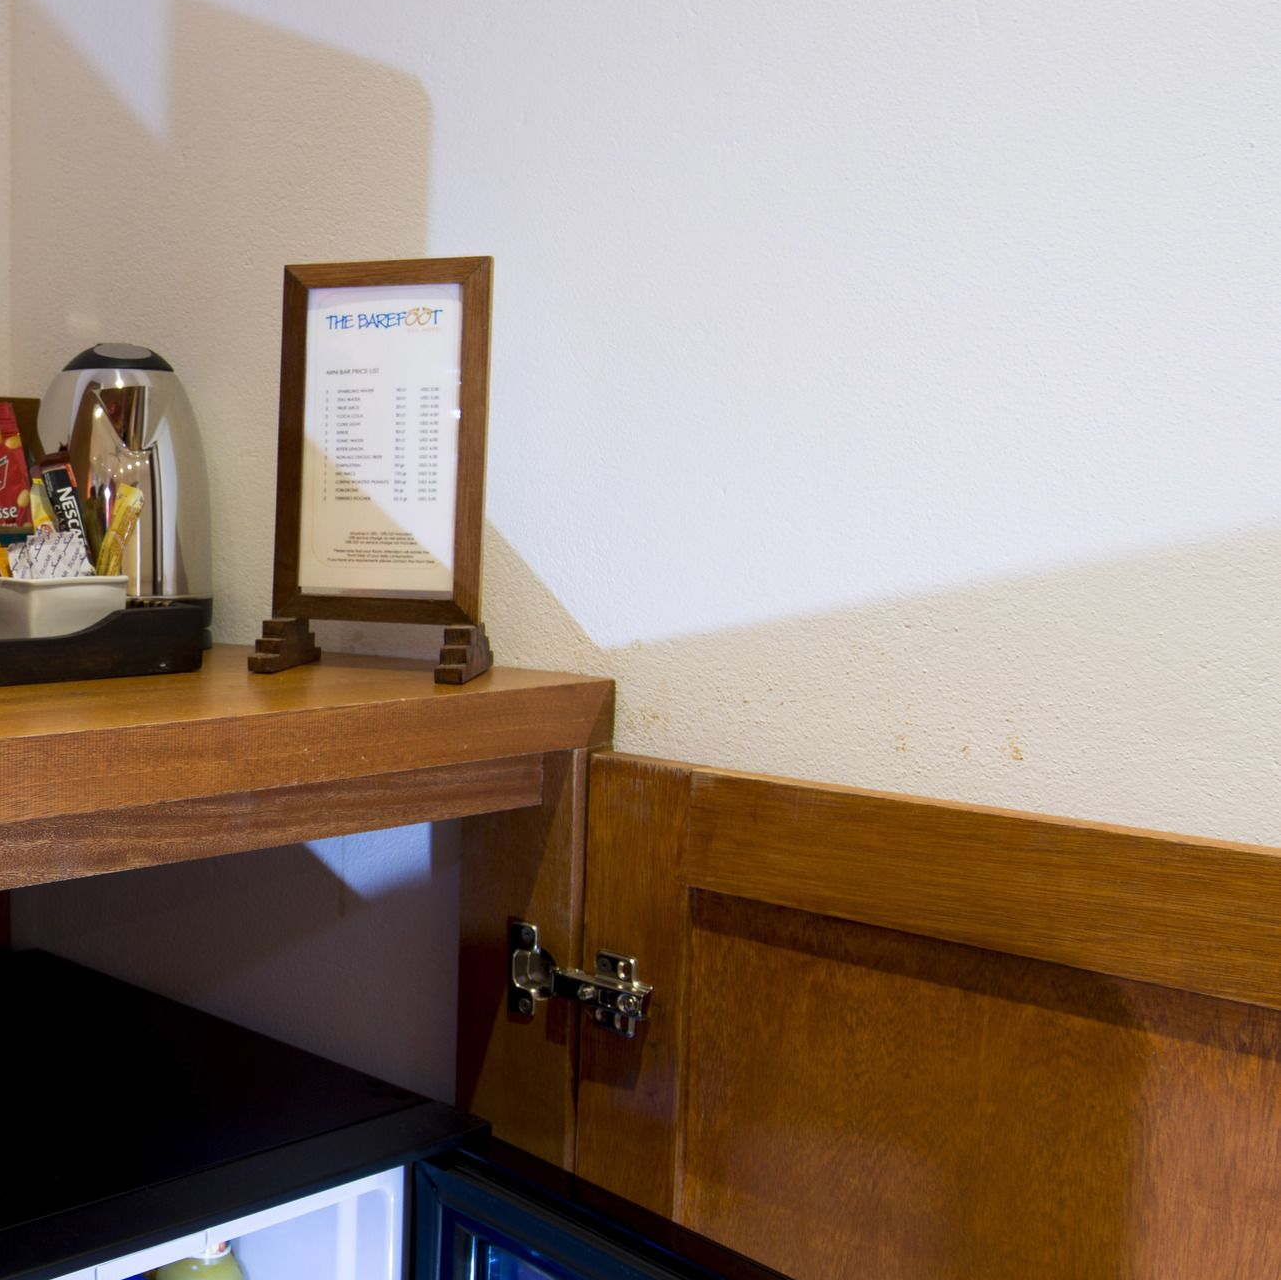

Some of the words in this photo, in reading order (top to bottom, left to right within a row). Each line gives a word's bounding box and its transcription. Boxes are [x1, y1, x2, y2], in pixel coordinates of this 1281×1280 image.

[325, 314, 355, 330] THE
[357, 306, 444, 329] BAREFOOT
[57, 486, 86, 542] NESCA
